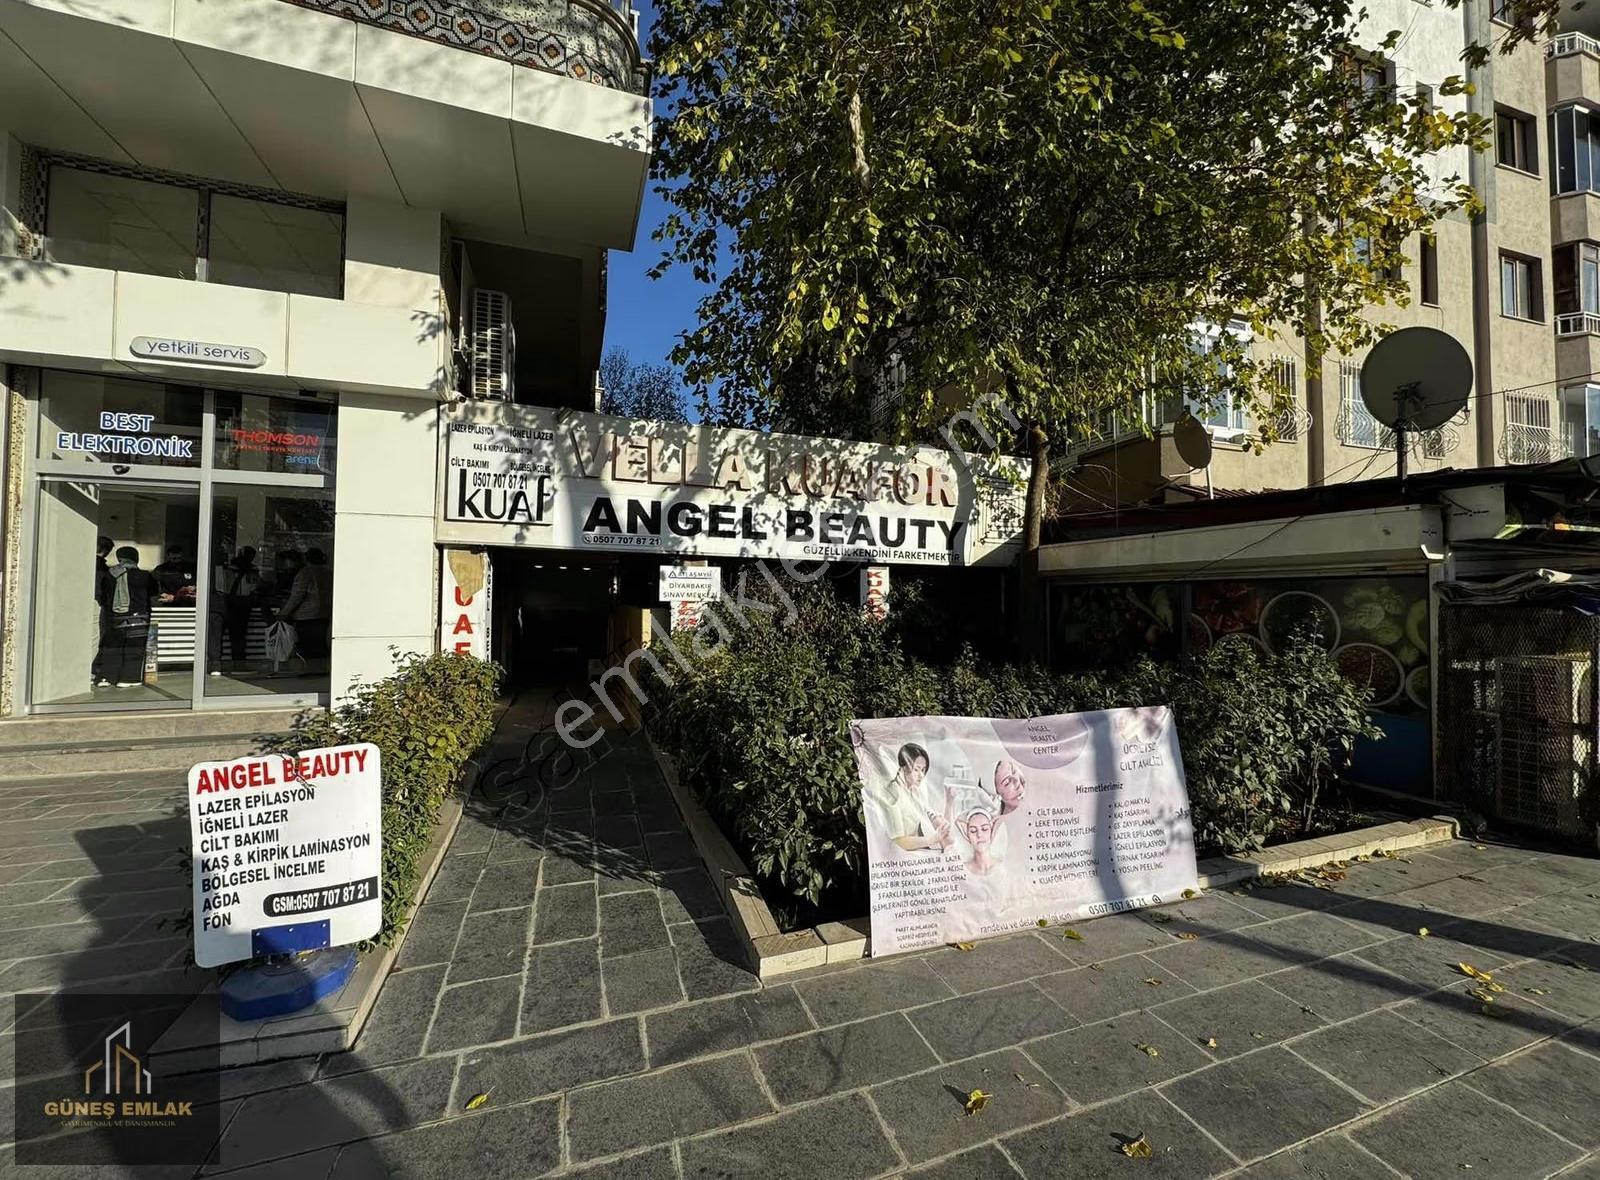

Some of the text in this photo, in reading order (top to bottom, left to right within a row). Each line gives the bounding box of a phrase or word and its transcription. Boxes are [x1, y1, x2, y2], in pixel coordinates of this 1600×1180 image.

[147, 340, 250, 360] yetkili servis
[100, 412, 154, 432] BEST
[57, 431, 193, 457] ELEKTRONİK
[231, 429, 320, 446] THOMSON
[533, 431, 554, 441] LAZER
[286, 455, 317, 464] arena
[450, 456, 490, 469] CİLT BAKIMI
[472, 472, 528, 490] 0507 707 87 21
[583, 497, 965, 551] ANGEL BEAUTY
[593, 535, 660, 546] 0507 707 87 21
[853, 547, 892, 559] KENDİNİ
[893, 550, 960, 562] FARKETMEKTİR
[1030, 734, 1057, 742] BEAUTY
[1033, 746, 1059, 755] CENTER
[196, 749, 369, 794] ANGEL BEAUTY
[1075, 782, 1124, 795] Hizmetlerimiz
[198, 788, 315, 816] LAZER EPİLASYON
[1051, 807, 1074, 815] BAKIMI
[199, 809, 289, 835] İĞNELİ LAZER
[1035, 819, 1051, 827] LEKE
[200, 828, 279, 853] CİLT BAKIMI
[1050, 829, 1069, 837] TONU
[1113, 831, 1131, 840] LAZER
[201, 833, 370, 873] KAŞ & KİRPİK LAMİNASYON
[1036, 853, 1049, 862] KAŞ
[201, 860, 325, 893] BÖLGESEL İNCELME
[1118, 865, 1139, 874] YOSUN
[202, 891, 241, 912] AĞDA
[272, 882, 370, 913] GSM:0507 707 87 21
[1088, 903, 1108, 914] 0507
[1109, 901, 1124, 911] 707
[203, 912, 232, 932] FÖN
